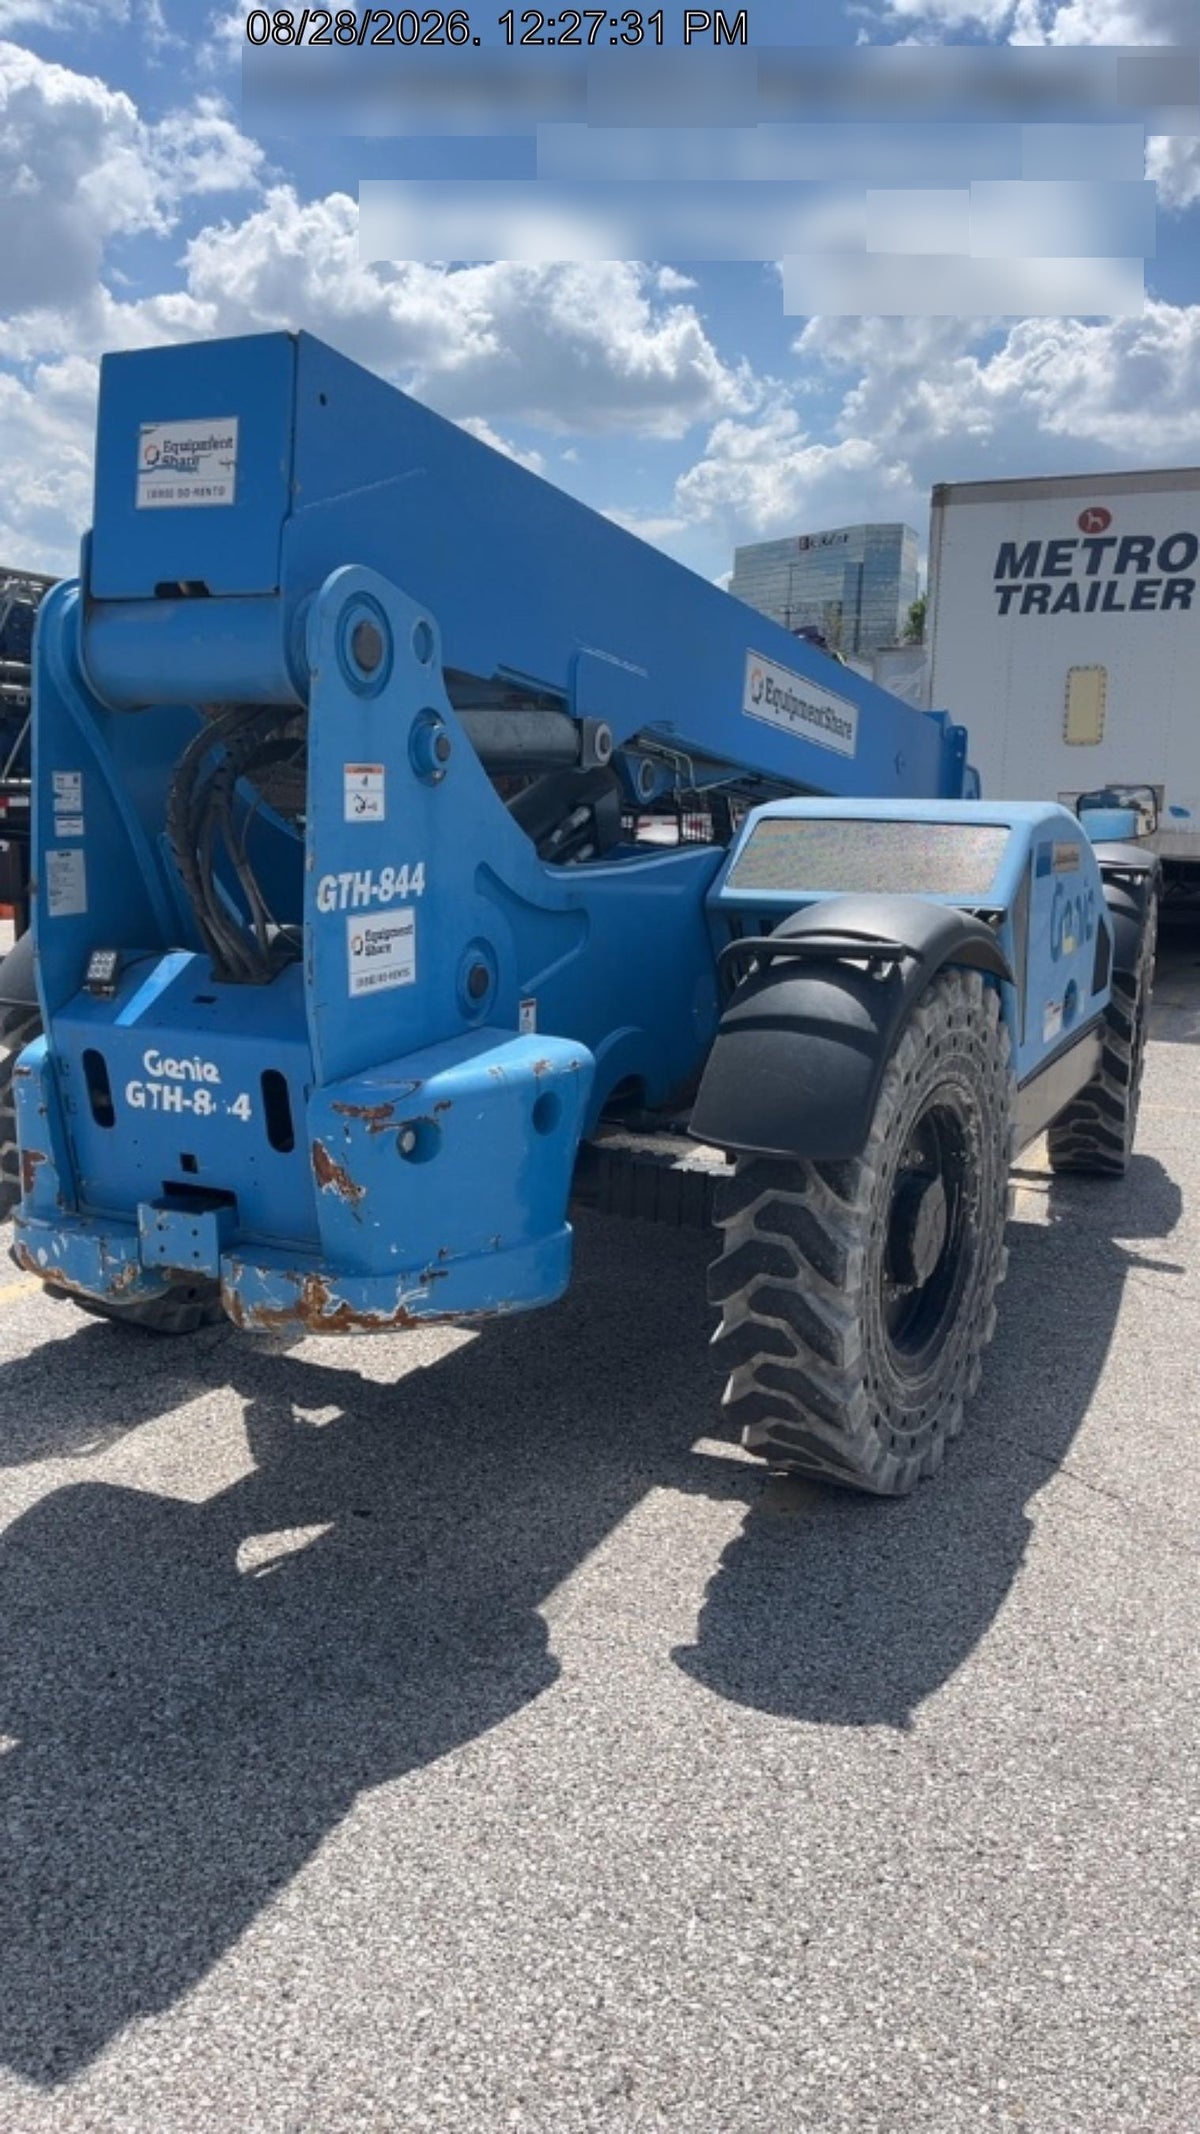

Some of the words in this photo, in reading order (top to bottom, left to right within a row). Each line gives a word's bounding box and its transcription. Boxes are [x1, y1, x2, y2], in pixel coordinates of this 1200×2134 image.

[993, 532, 1199, 579] METRO
[994, 578, 1196, 616] TRAILER
[765, 677, 853, 741] EquipmentShare
[317, 862, 426, 913] GTH-844
[143, 1049, 222, 1084] Genie
[125, 1080, 252, 1122] GTH-84
